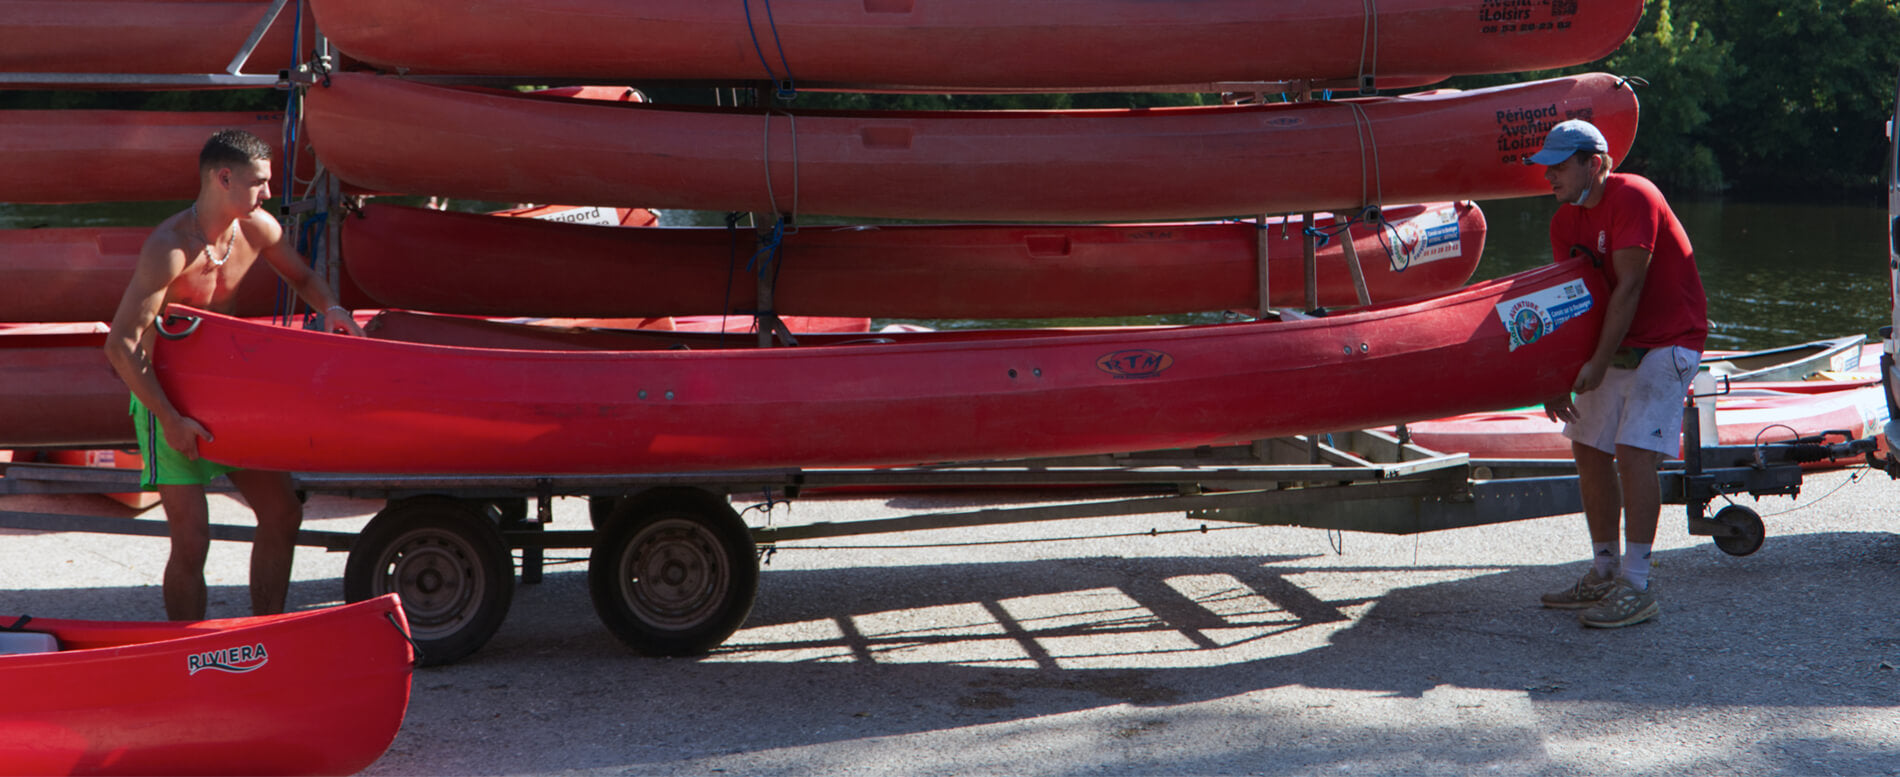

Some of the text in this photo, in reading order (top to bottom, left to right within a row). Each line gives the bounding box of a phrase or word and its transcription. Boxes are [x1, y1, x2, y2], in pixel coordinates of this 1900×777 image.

[1496, 104, 1557, 124] Périgord
[1100, 354, 1164, 370] RTM
[187, 642, 268, 671] RIVIERA
